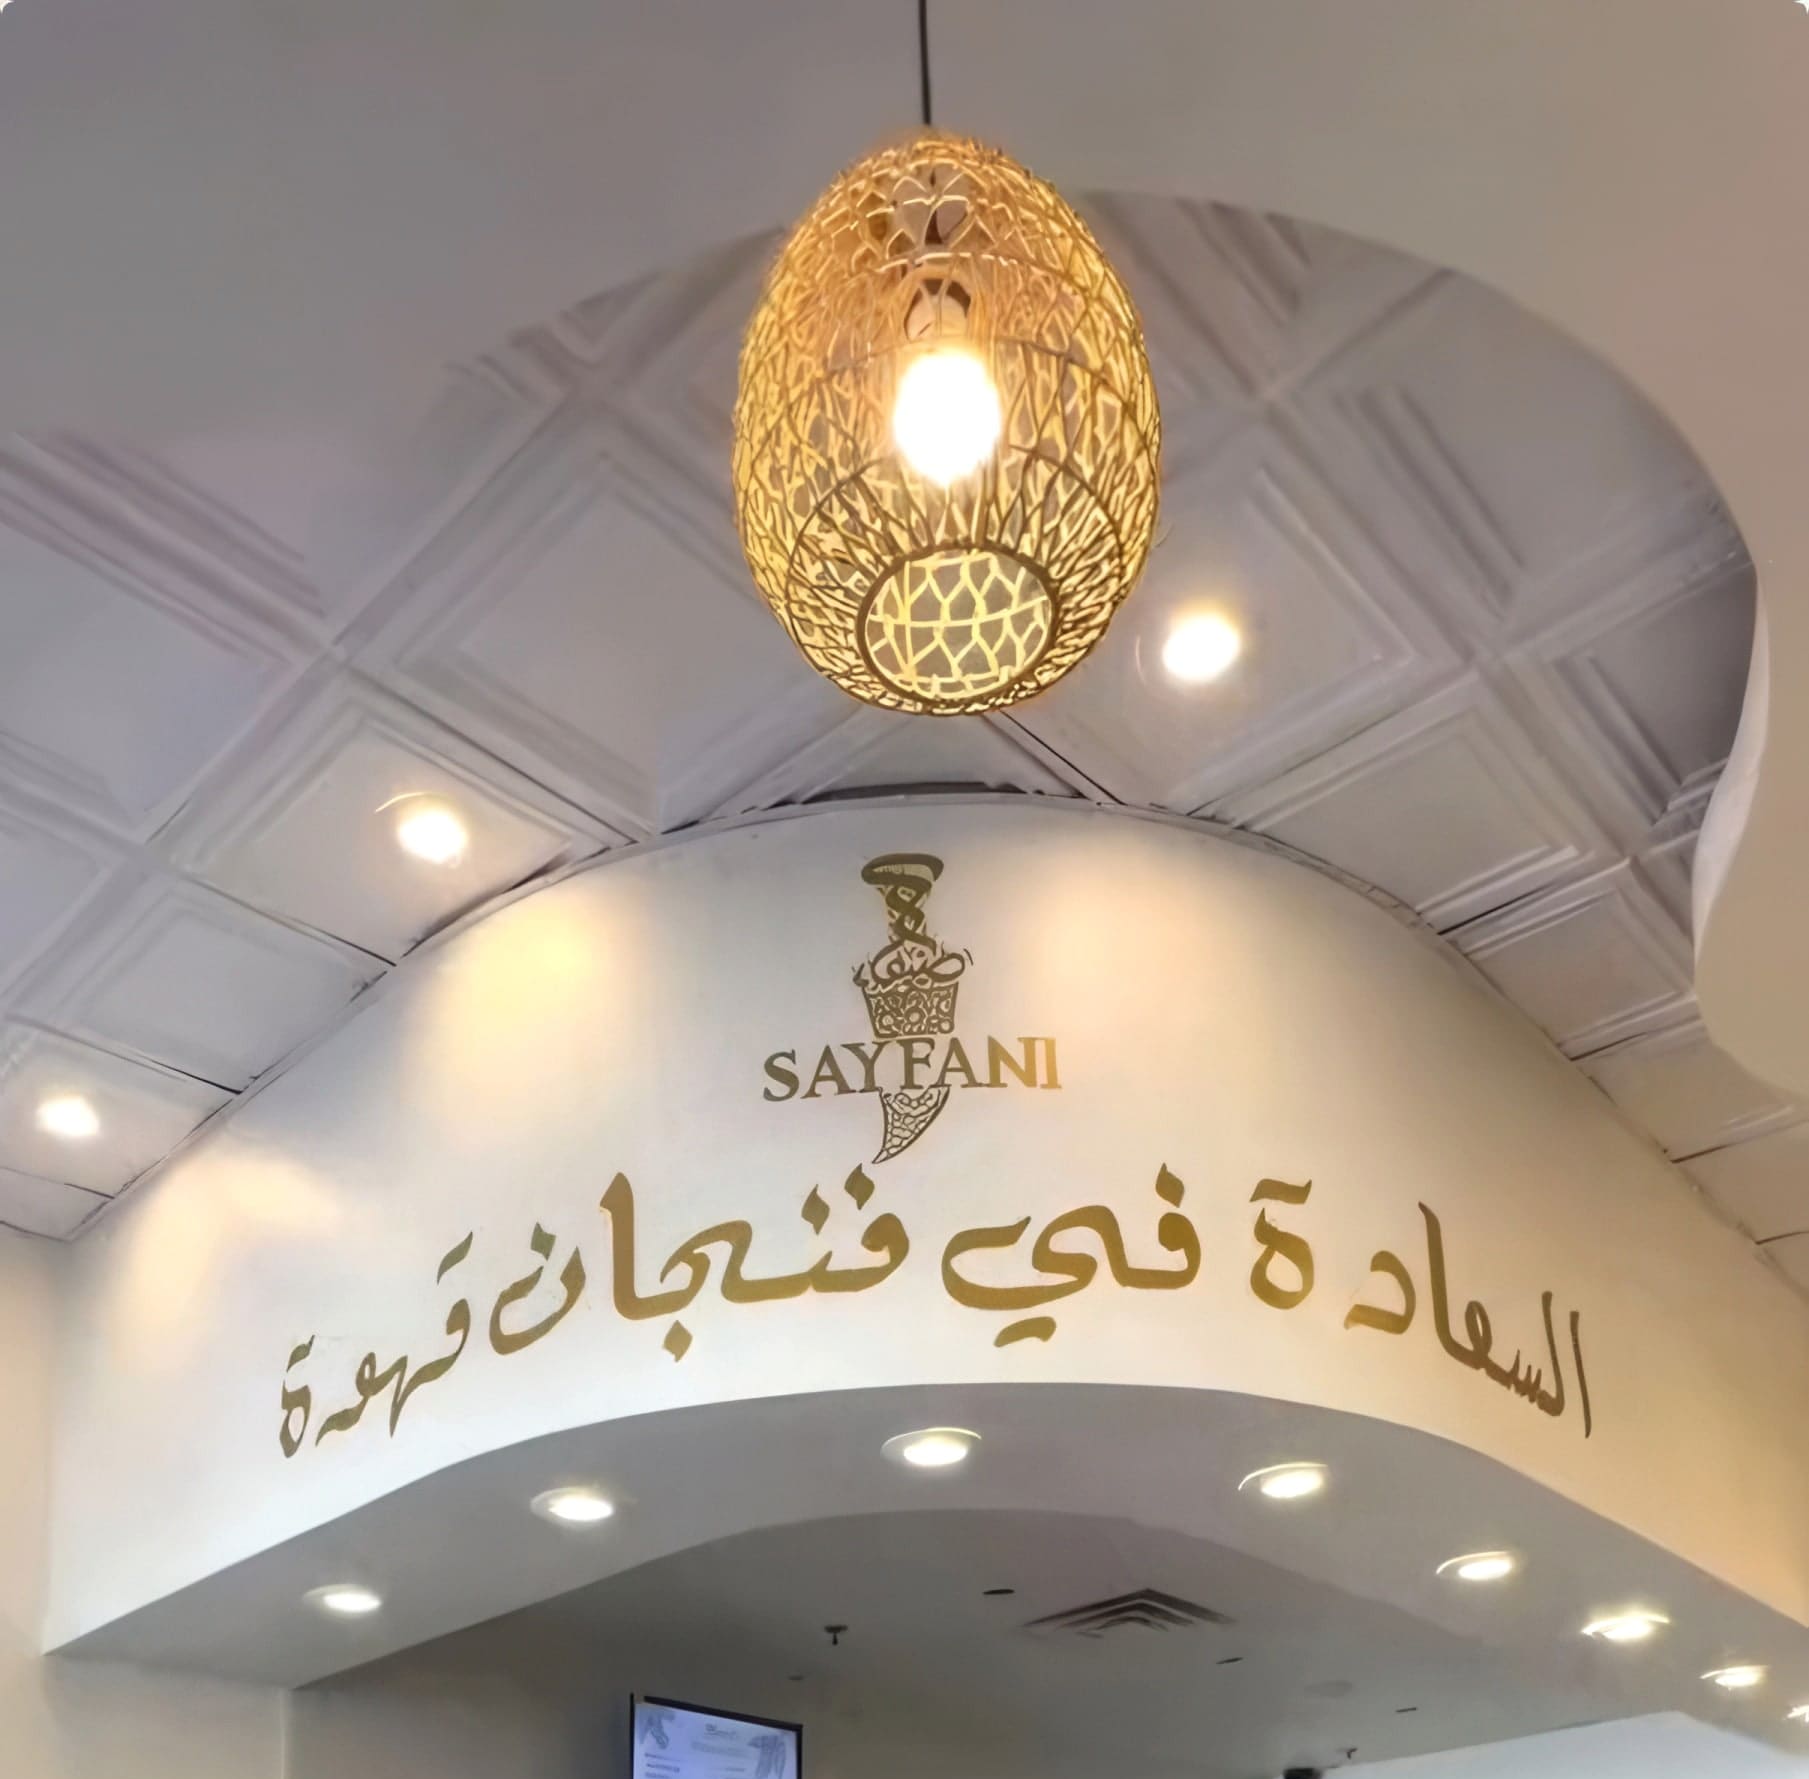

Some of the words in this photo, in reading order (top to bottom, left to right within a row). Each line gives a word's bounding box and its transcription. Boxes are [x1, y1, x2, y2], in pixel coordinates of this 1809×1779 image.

[763, 1036, 1062, 1102] SAYFANI
[279, 1230, 475, 1459] قهوة
[488, 1162, 910, 1361] فنجان
[941, 1162, 1202, 1348] في
[1250, 1178, 1592, 1439] السعادة
